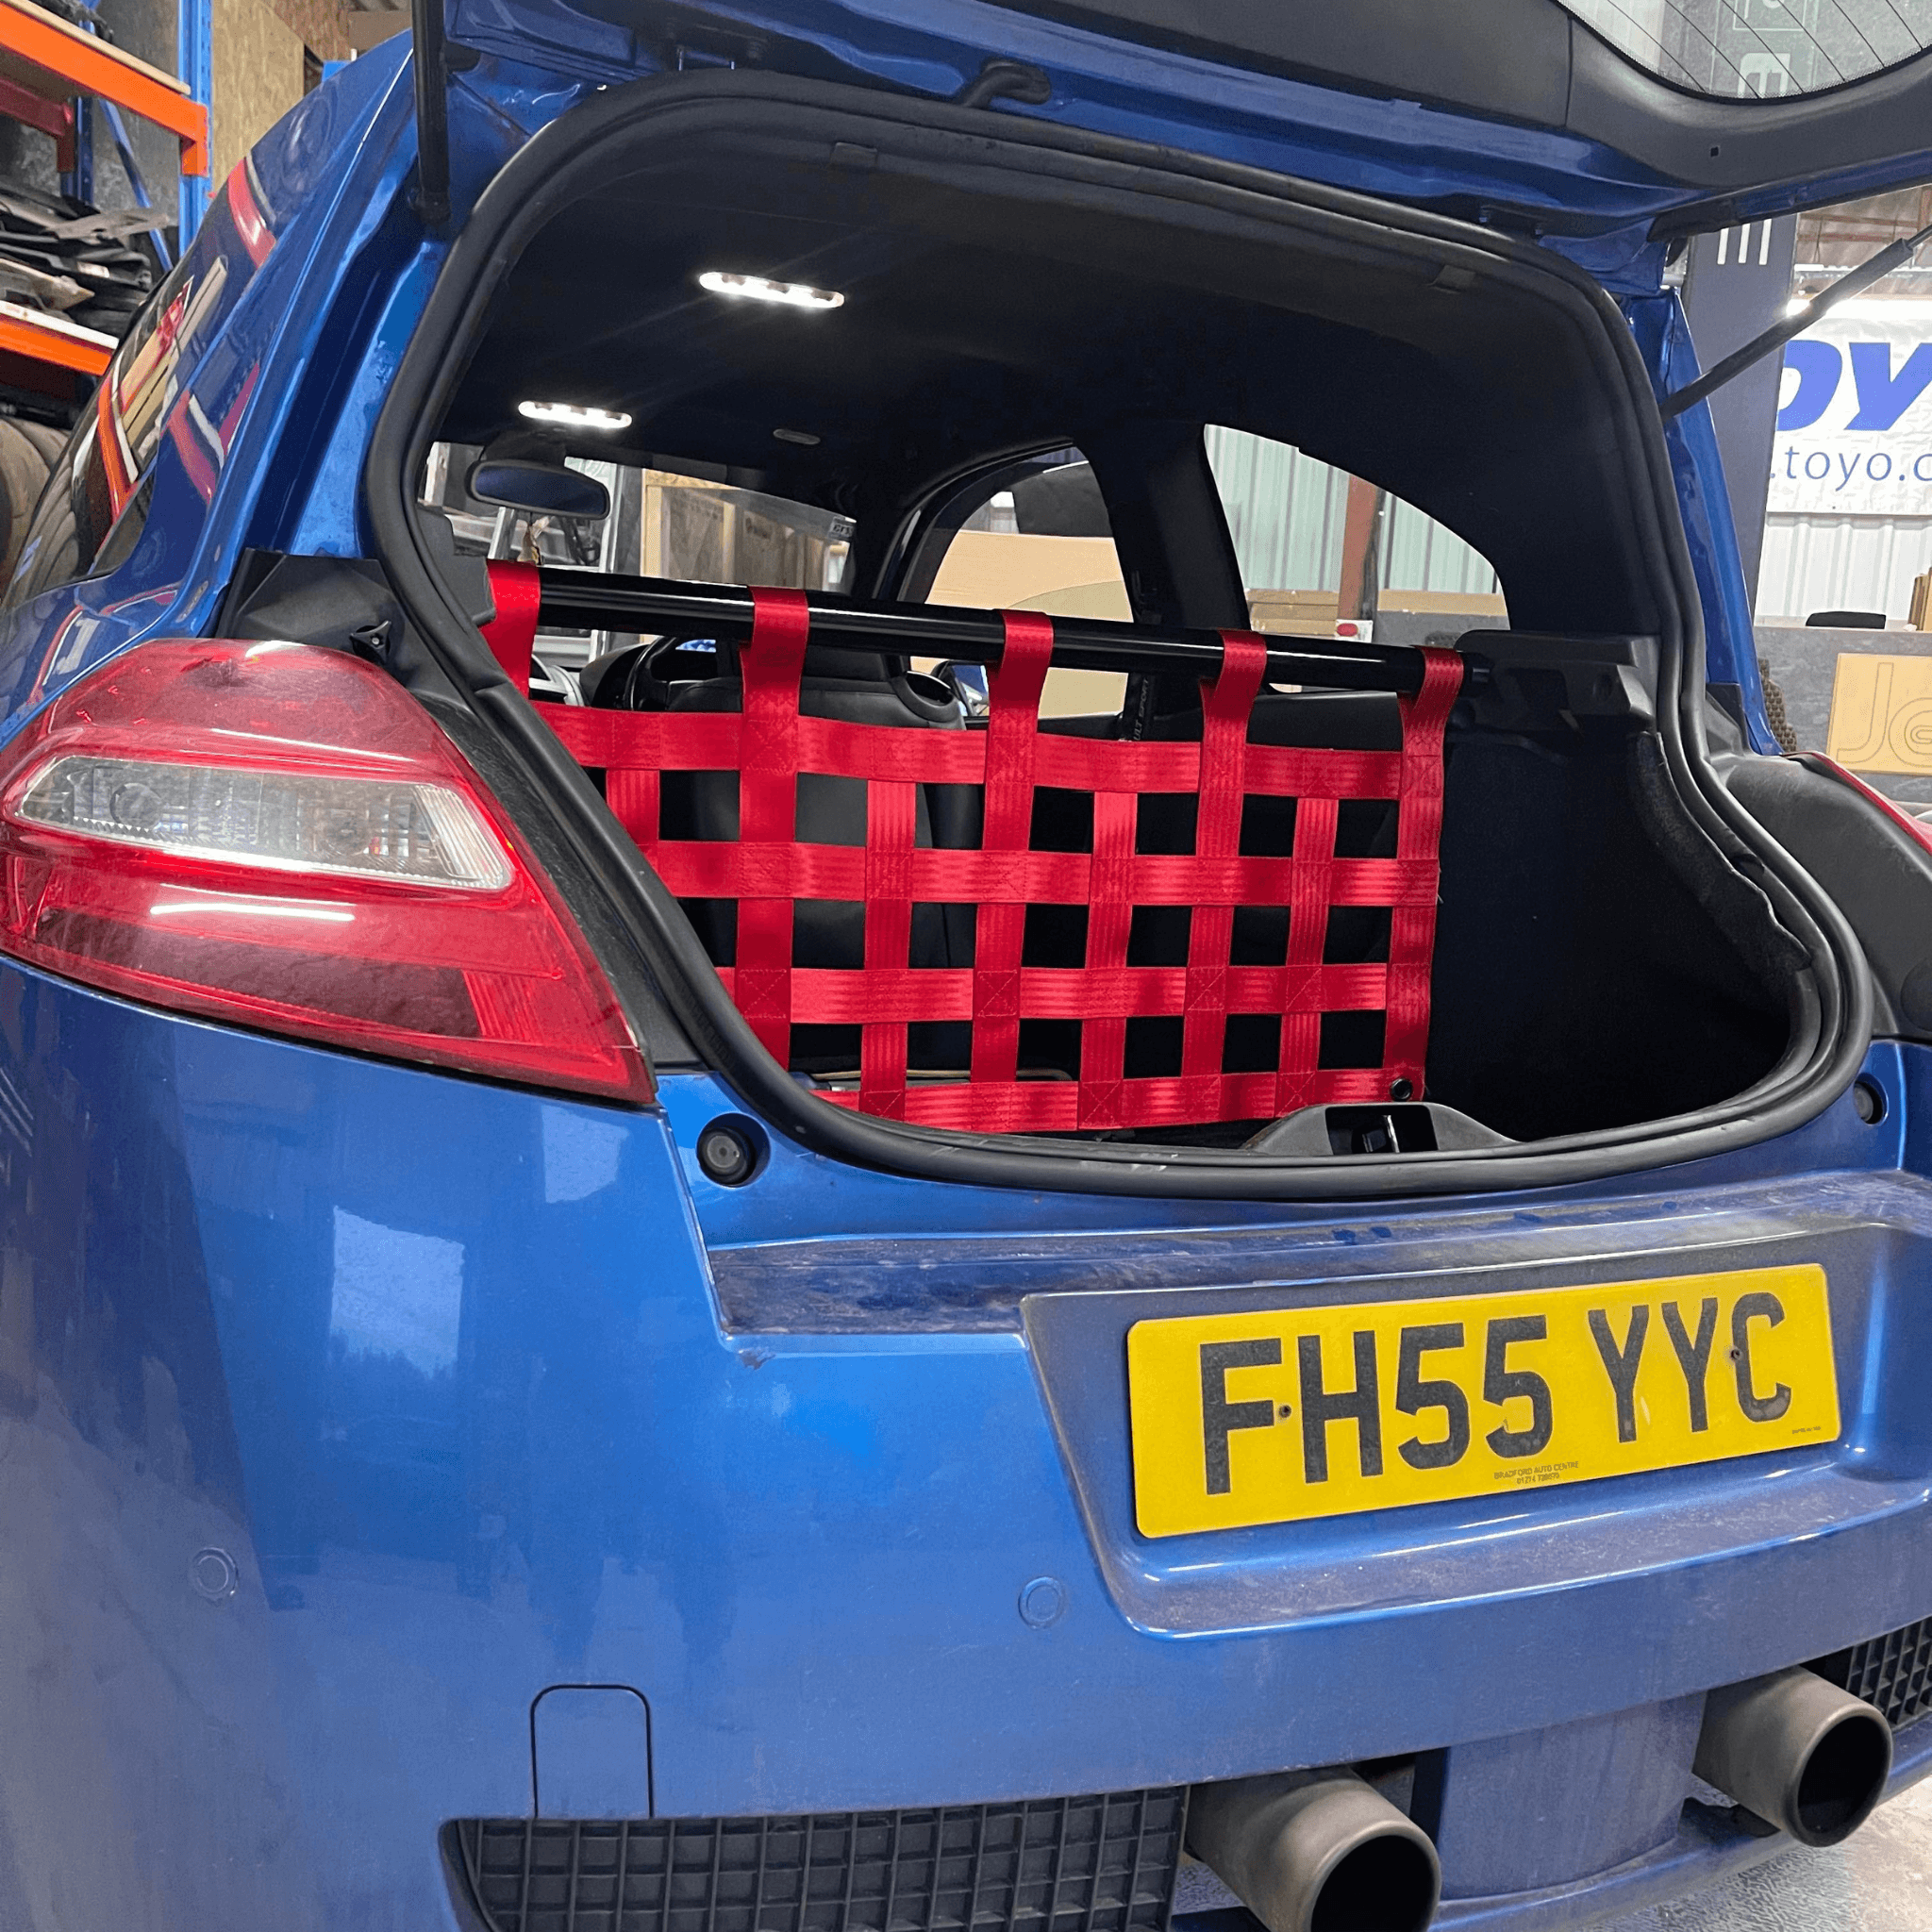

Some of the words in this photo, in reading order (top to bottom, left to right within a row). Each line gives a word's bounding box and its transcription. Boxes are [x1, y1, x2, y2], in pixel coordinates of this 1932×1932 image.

[1200, 1314, 1554, 1495] FH55
[1588, 1292, 1792, 1444] YYC
[1493, 1468, 1533, 1479] BRADFORD
[1533, 1464, 1553, 1474] AUTO
[1553, 1461, 1579, 1472] CENTRE
